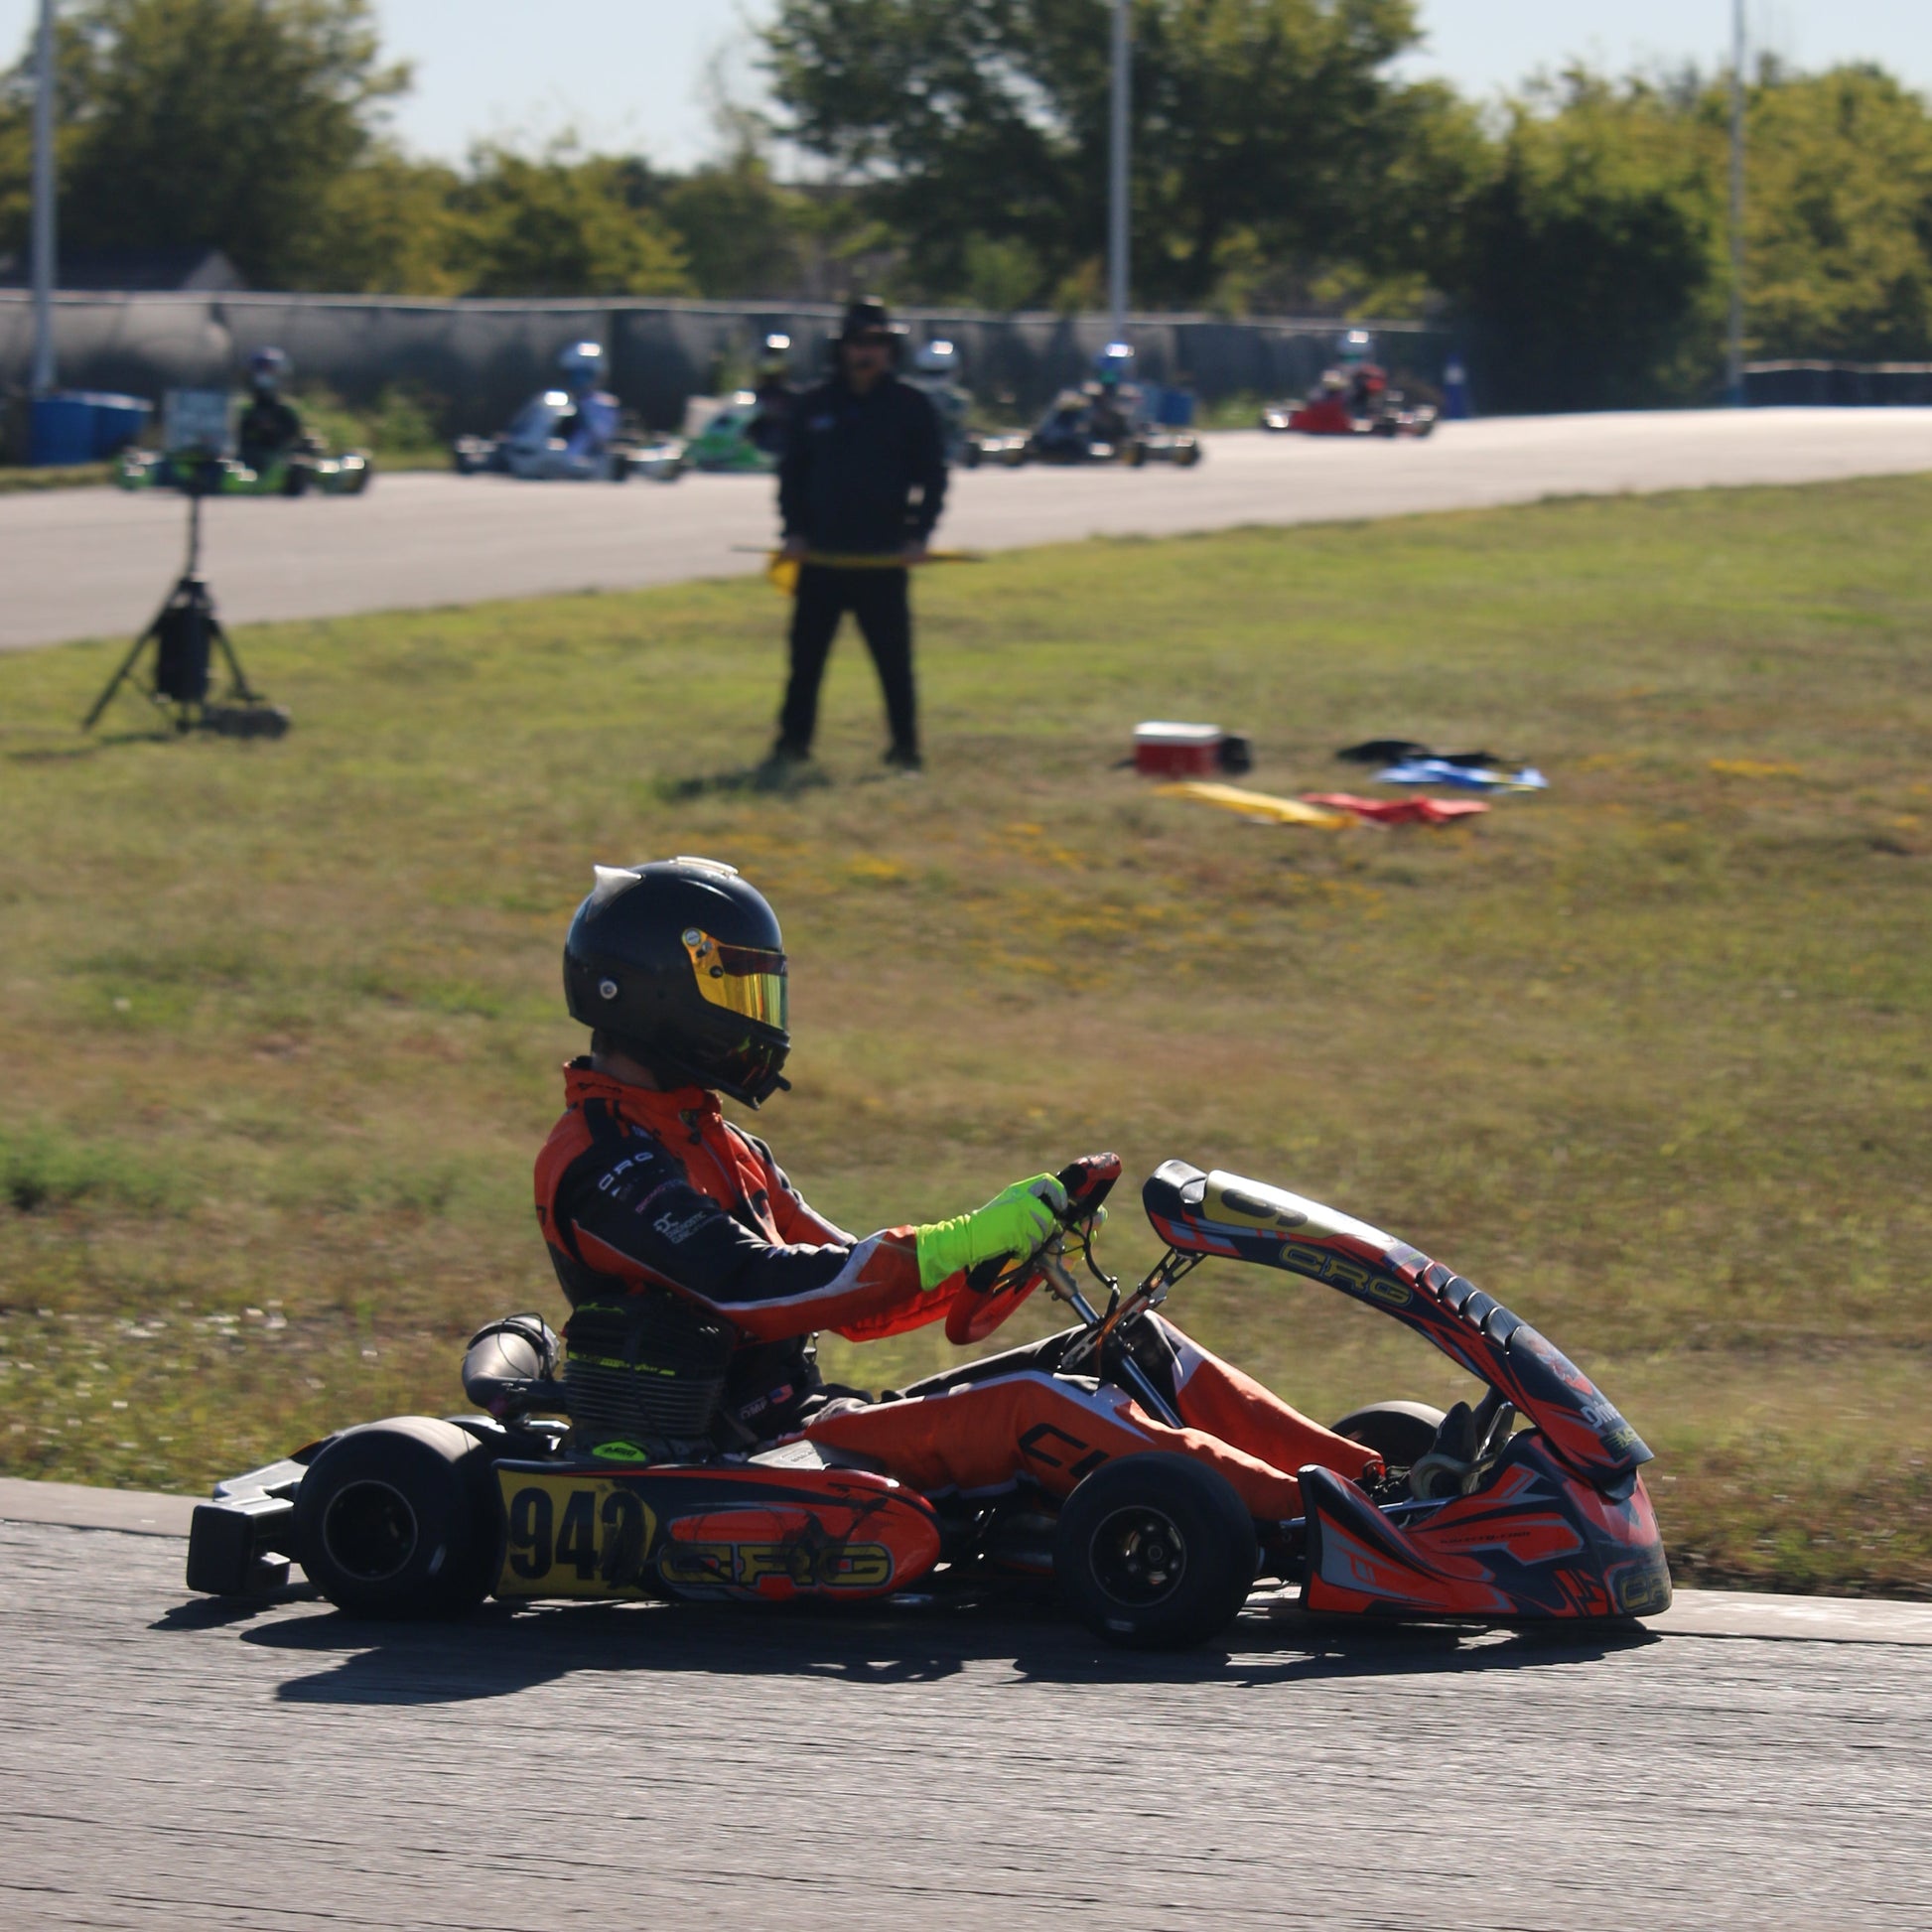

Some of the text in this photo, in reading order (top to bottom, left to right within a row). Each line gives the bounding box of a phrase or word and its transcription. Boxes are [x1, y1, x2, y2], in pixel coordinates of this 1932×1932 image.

[599, 1152, 654, 1191] CRG
[1280, 1243, 1412, 1306] CRG
[659, 1542, 894, 1589] CRG
